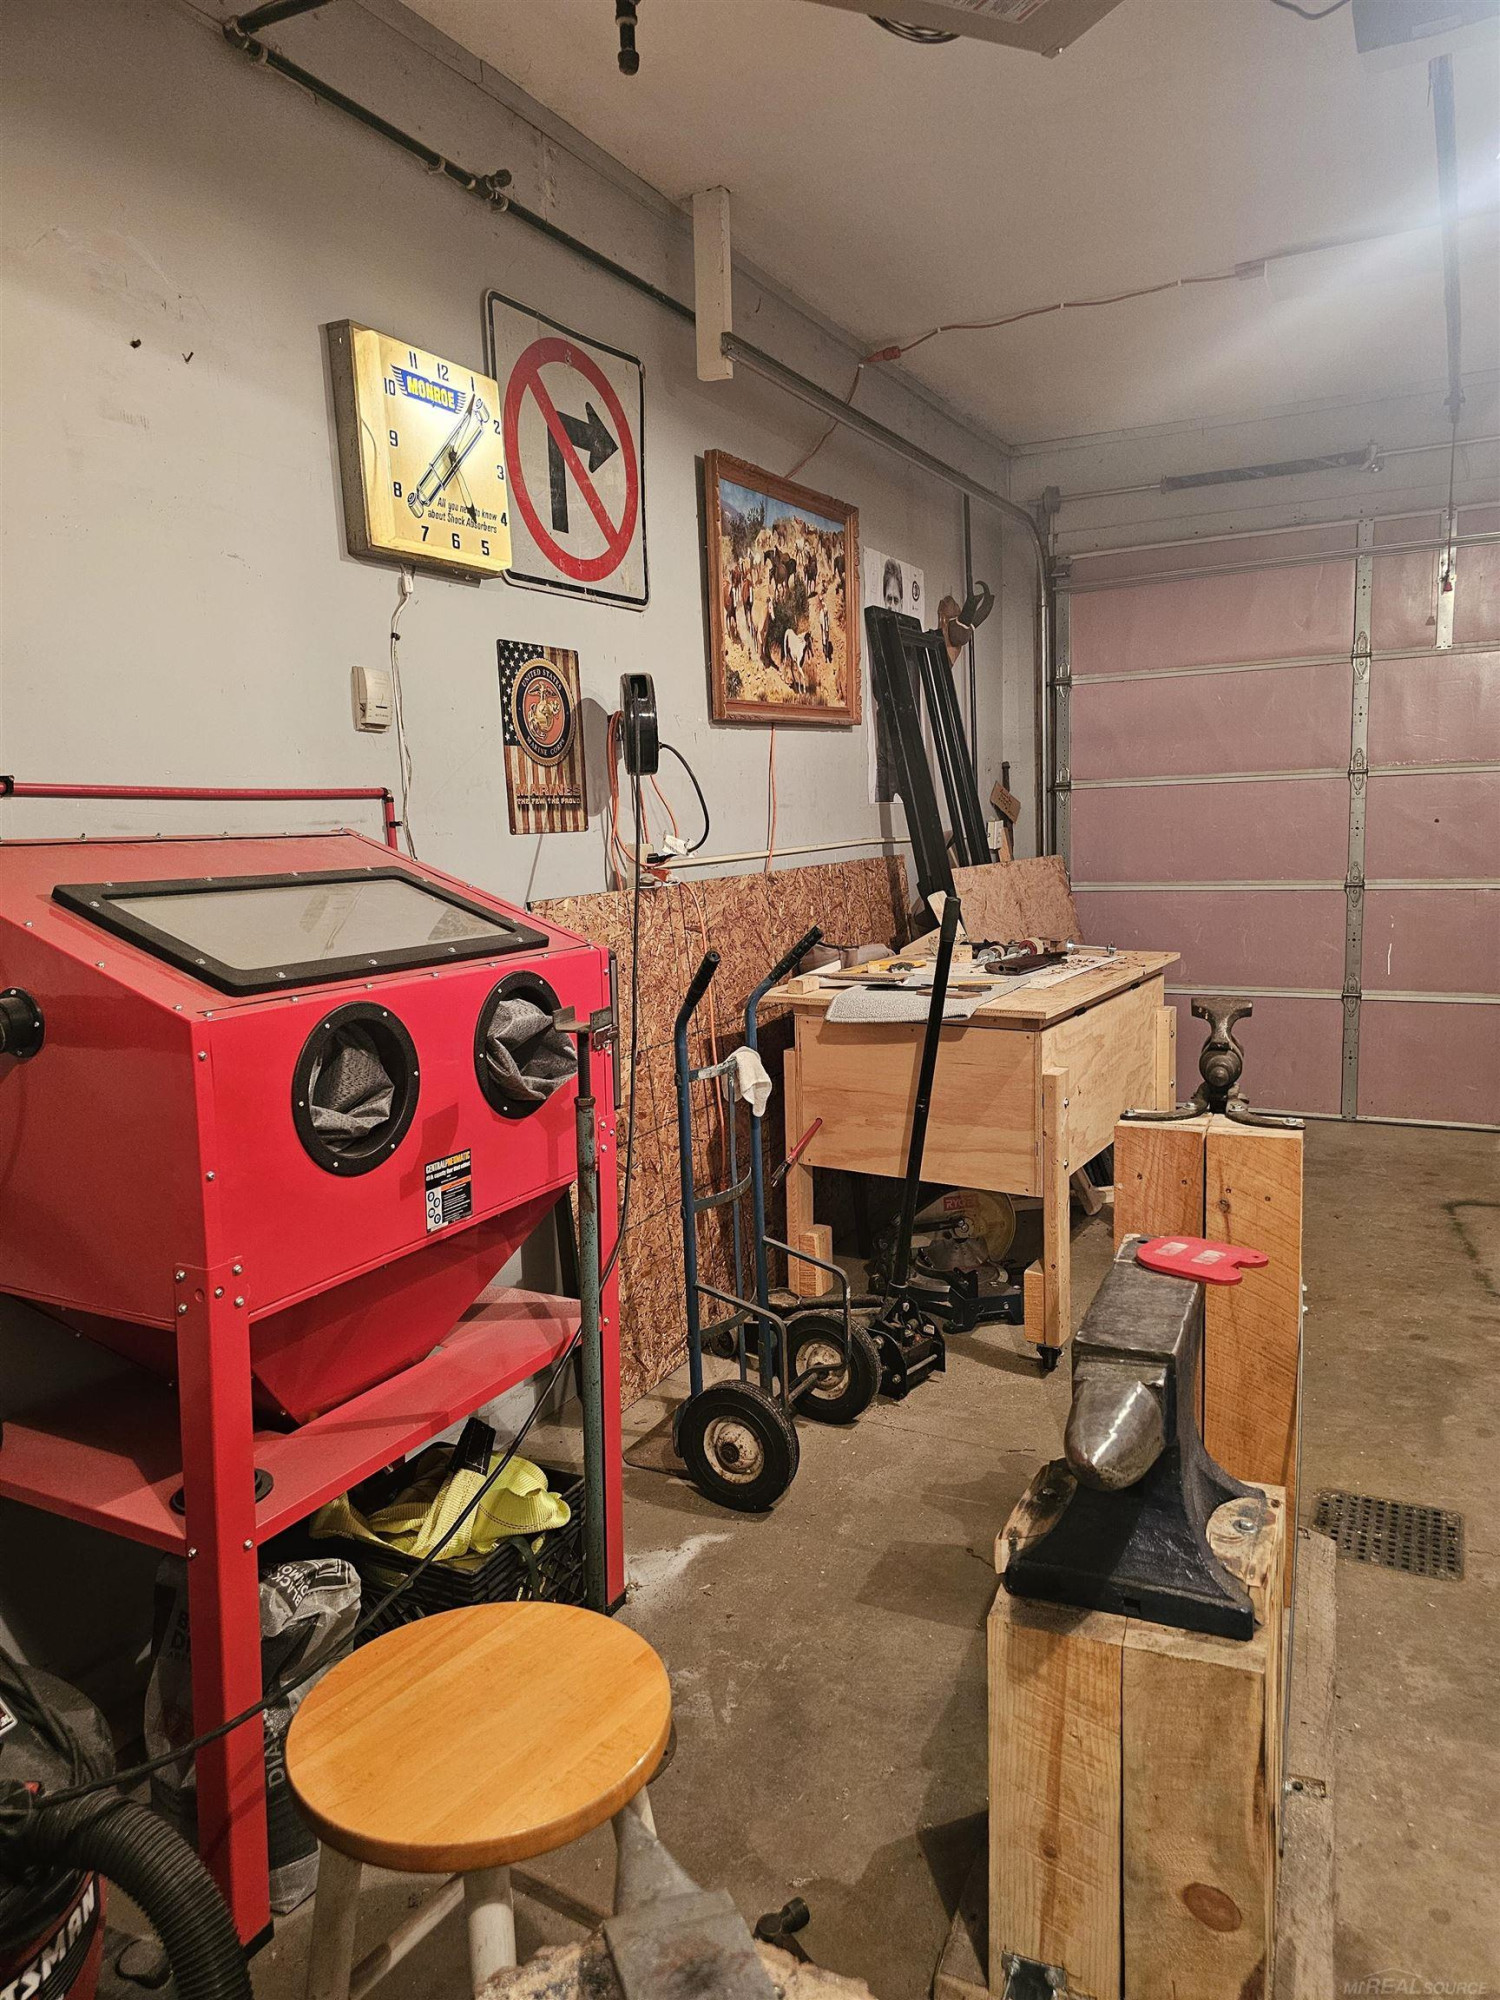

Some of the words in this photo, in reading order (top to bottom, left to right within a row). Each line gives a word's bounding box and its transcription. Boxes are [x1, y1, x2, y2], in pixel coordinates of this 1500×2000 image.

[409, 351, 418, 369] 11
[437, 362, 449, 381] 12
[383, 377, 396, 396] 10
[406, 375, 456, 409] MONROE
[493, 420, 501, 435] 2
[389, 430, 398, 447] 9
[496, 465, 505, 480] 3
[393, 481, 402, 498] 8
[437, 497, 447, 508] All
[448, 499, 459, 513] you
[481, 510, 498, 521] know
[427, 509, 446, 522] about
[447, 512, 465, 526] Shock
[465, 516, 498, 534] Absorbers
[500, 512, 508, 527] 4
[421, 525, 429, 542] 7
[451, 533, 461, 549] 6
[481, 540, 490, 556] 5
[521, 668, 541, 688] UNITED
[542, 668, 562, 691] STATES
[526, 735, 548, 756] MARINE
[516, 784, 581, 796] MARINES
[271, 1572, 303, 1608] BLACK
